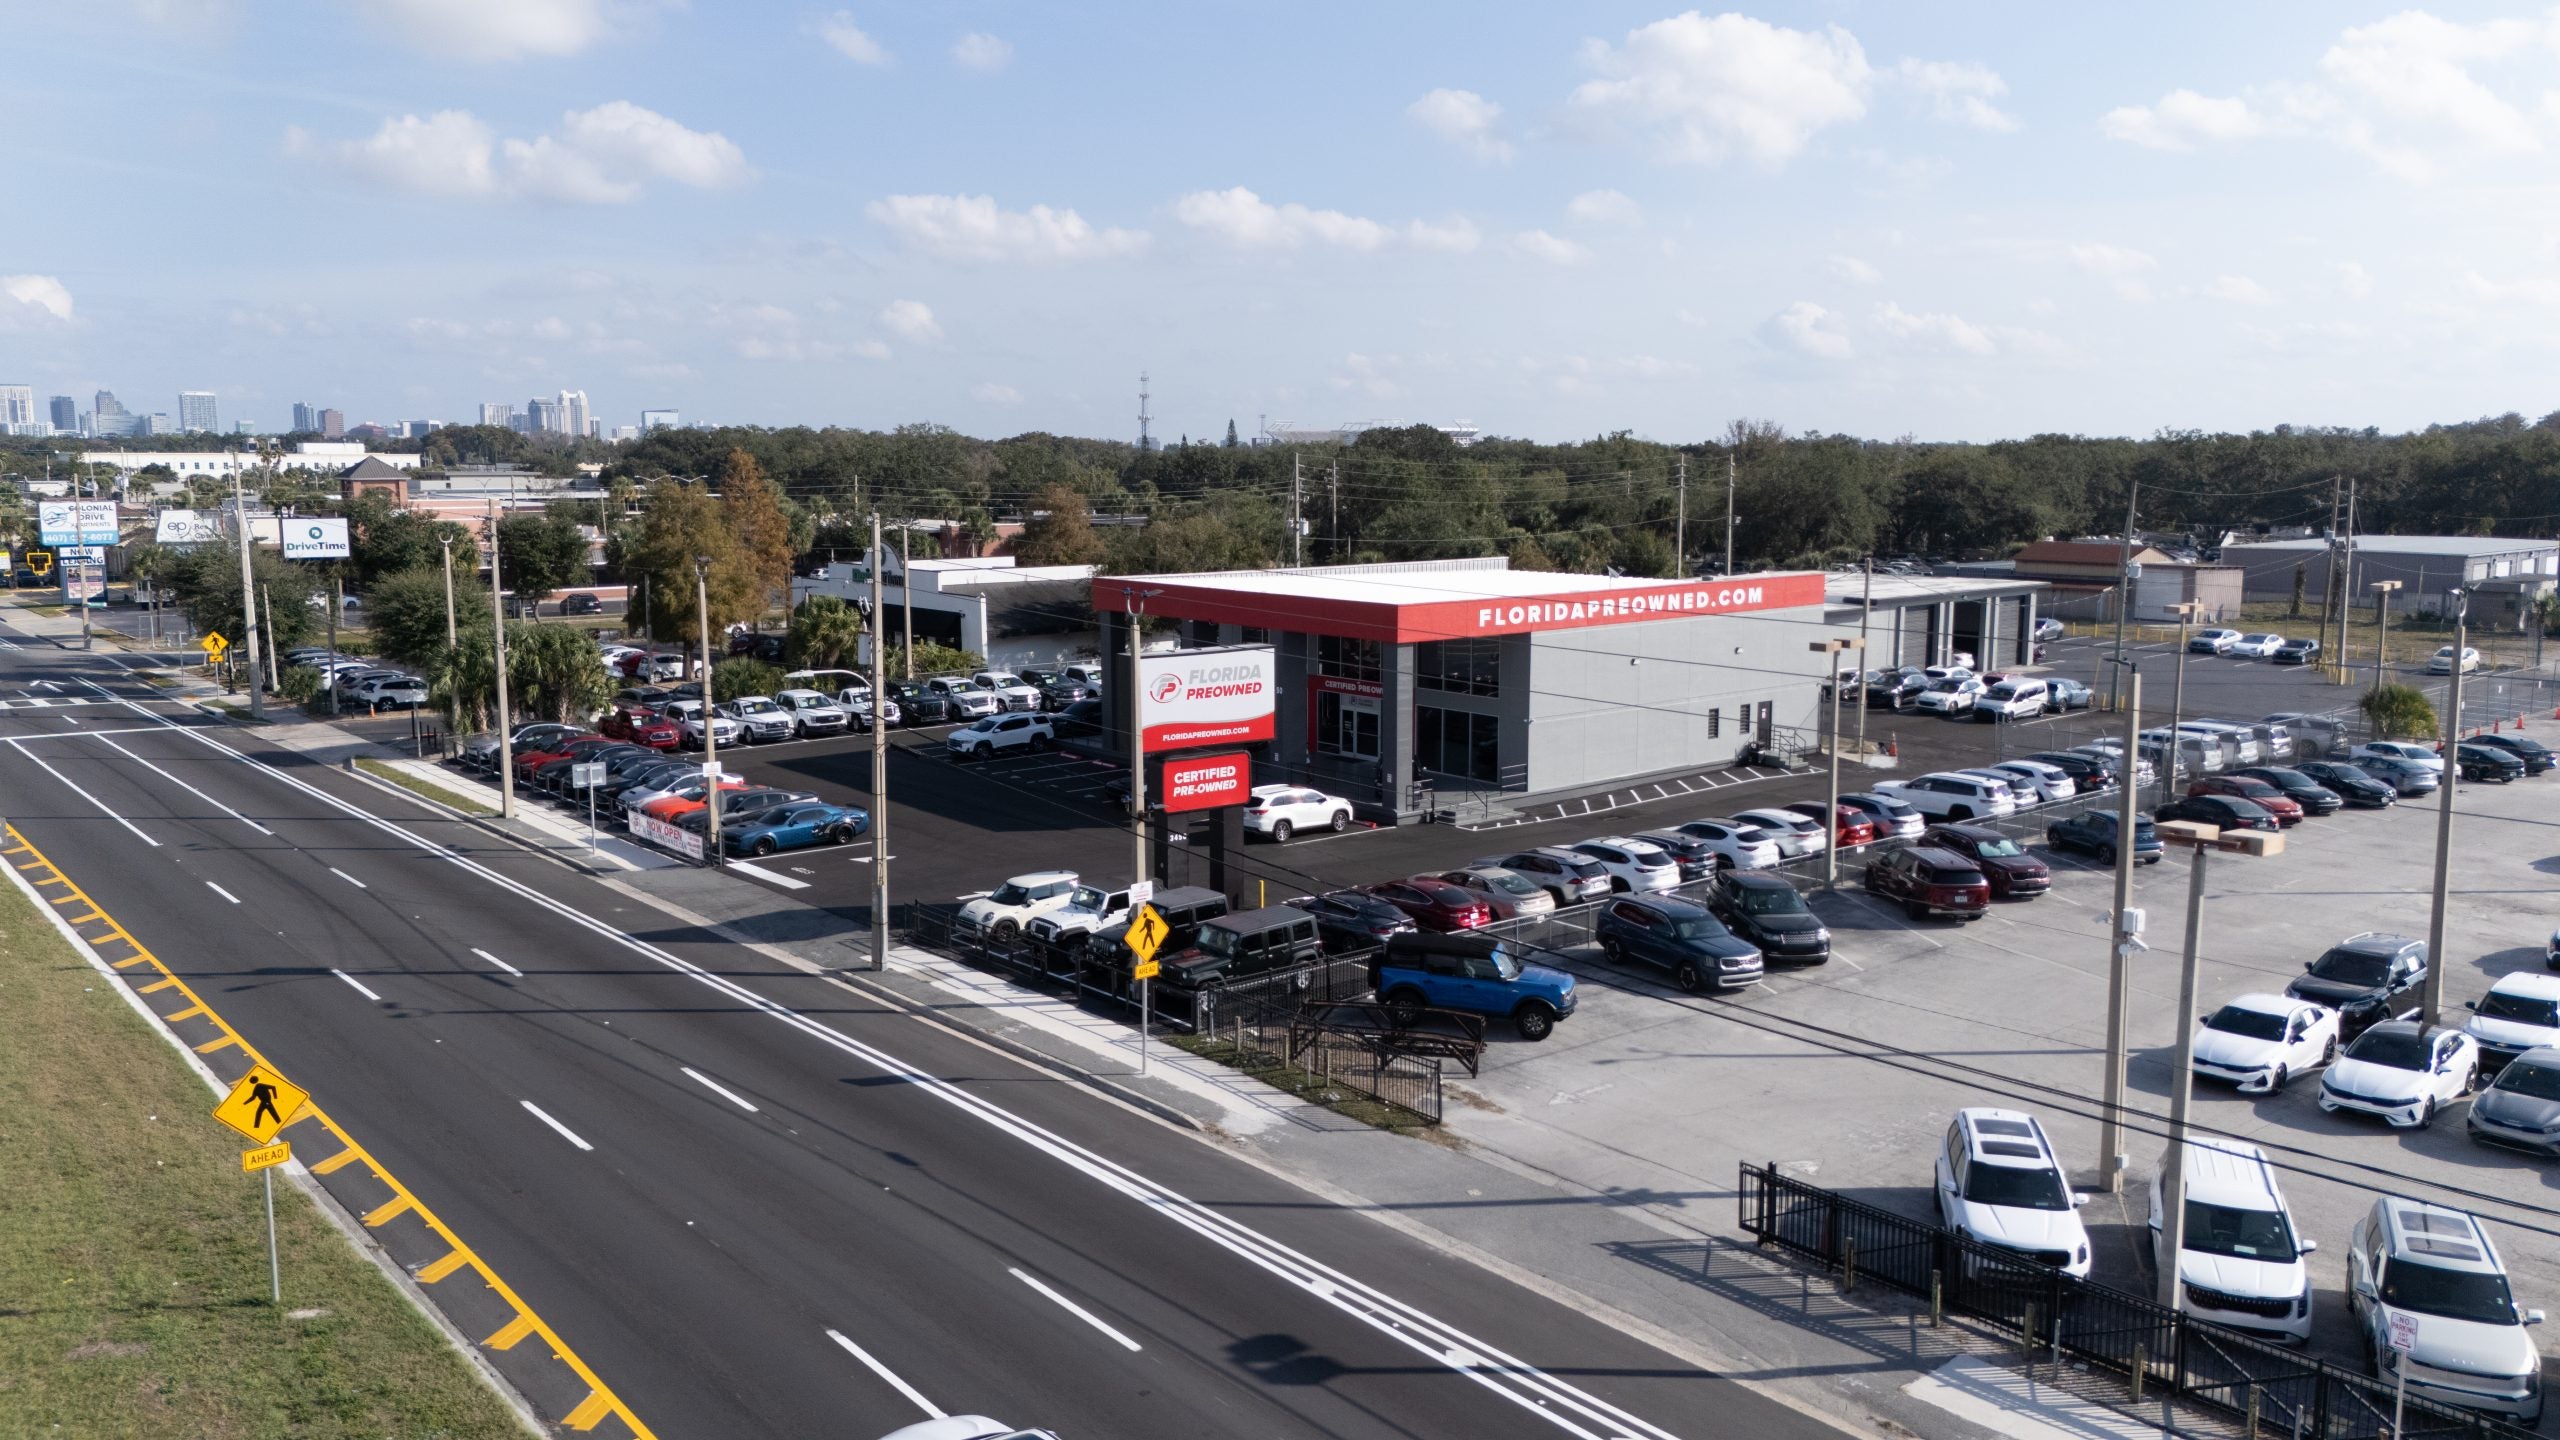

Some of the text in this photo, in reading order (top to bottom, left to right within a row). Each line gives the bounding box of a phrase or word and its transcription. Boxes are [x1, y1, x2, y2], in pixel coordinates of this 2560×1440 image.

[286, 541, 346, 550] DriveTime
[1478, 587, 1763, 628] FLORIDAPREOWNED.COM
[1188, 664, 1262, 685] FLORIDA
[1186, 682, 1263, 700] PREOWNED
[1324, 680, 1357, 691] CERTIFIED
[1162, 726, 1250, 742] FLORIDAPREOWNED.COM
[1174, 765, 1236, 784] CERTIFIED
[1173, 779, 1238, 797] PRE-OWNED
[646, 819, 663, 833] NOW
[664, 825, 683, 841] OPEN
[1138, 965, 1156, 975] AHEAD
[250, 1148, 284, 1165] AHEAD
[2391, 1321, 2416, 1335] PARKING
[2399, 1317, 2409, 1325] NO
